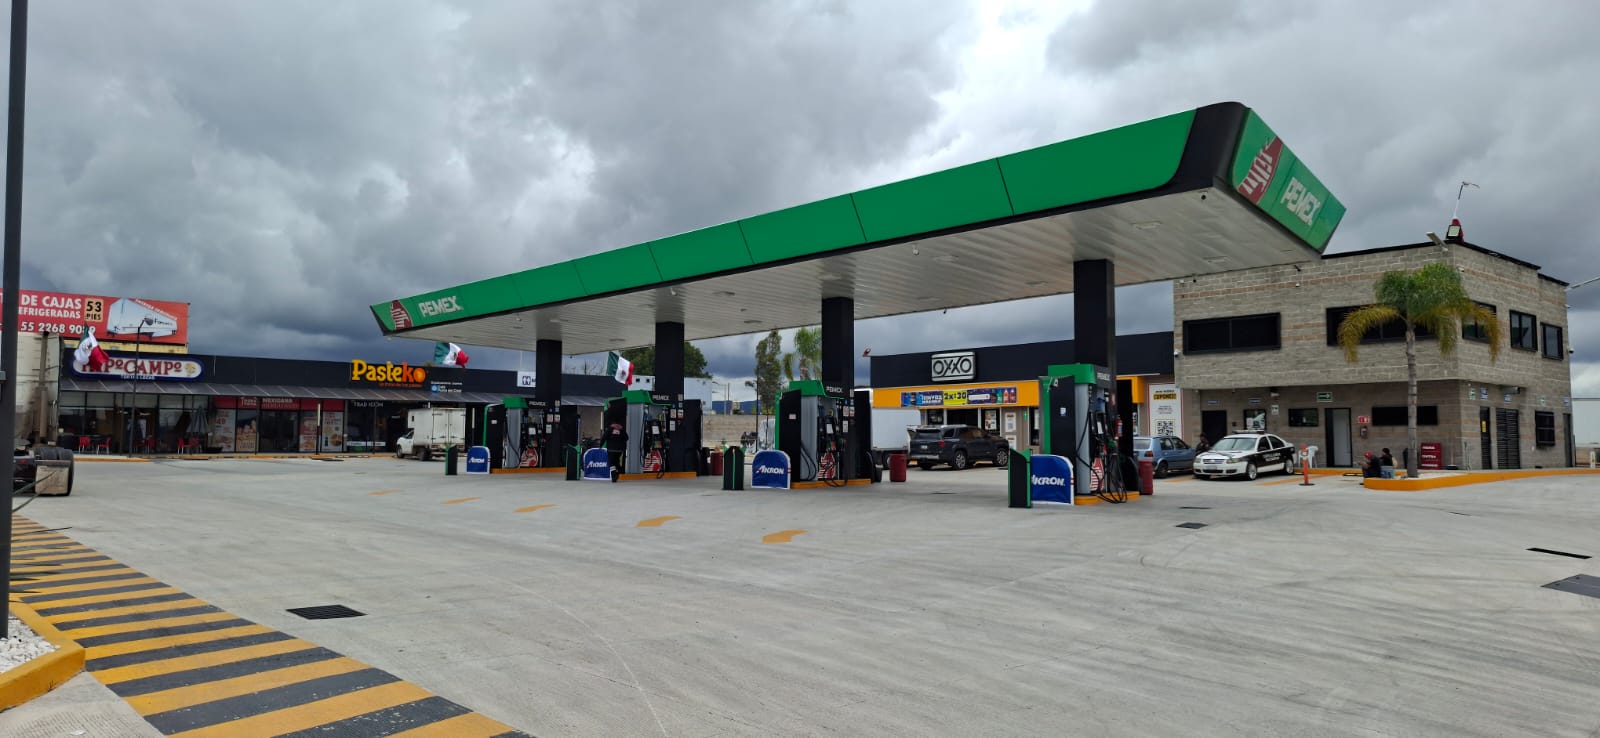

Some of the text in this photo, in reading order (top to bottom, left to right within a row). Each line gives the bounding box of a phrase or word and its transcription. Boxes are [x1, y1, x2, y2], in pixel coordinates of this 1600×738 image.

[1280, 177, 1321, 227] PEMEX
[21, 295, 82, 310] DE CAJAS
[86, 301, 102, 312] 53
[418, 296, 460, 317] PEMEX
[18, 306, 81, 319] EFRIGERADAS
[20, 321, 96, 335] 55 2268 909
[351, 359, 426, 383] Pasteko
[932, 357, 972, 376] OXXO
[756, 465, 785, 475] AKRON
